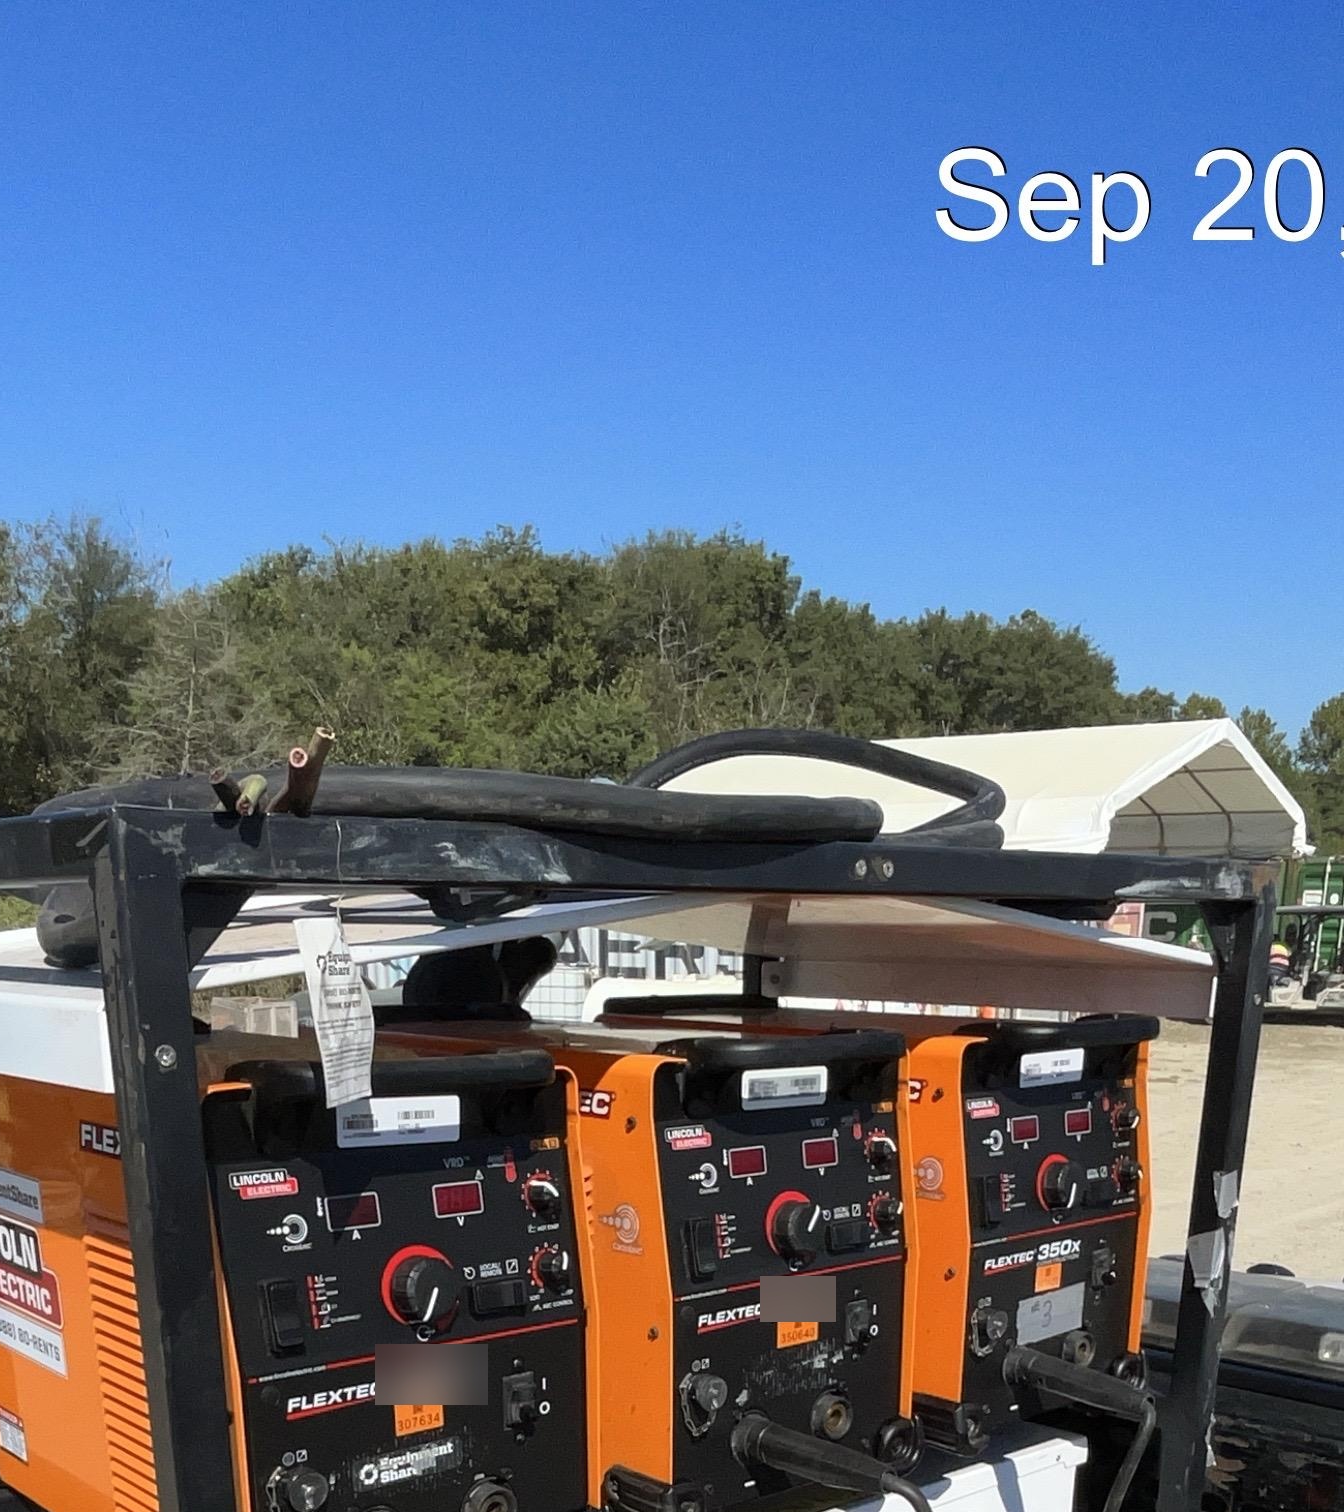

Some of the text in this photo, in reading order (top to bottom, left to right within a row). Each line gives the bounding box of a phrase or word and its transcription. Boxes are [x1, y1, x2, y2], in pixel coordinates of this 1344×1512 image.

[232, 1171, 285, 1187] LINCOLN
[246, 1182, 293, 1196] ELECTRIC
[985, 1250, 1035, 1270] FLEXTEC
[398, 1413, 441, 1432] 307634
